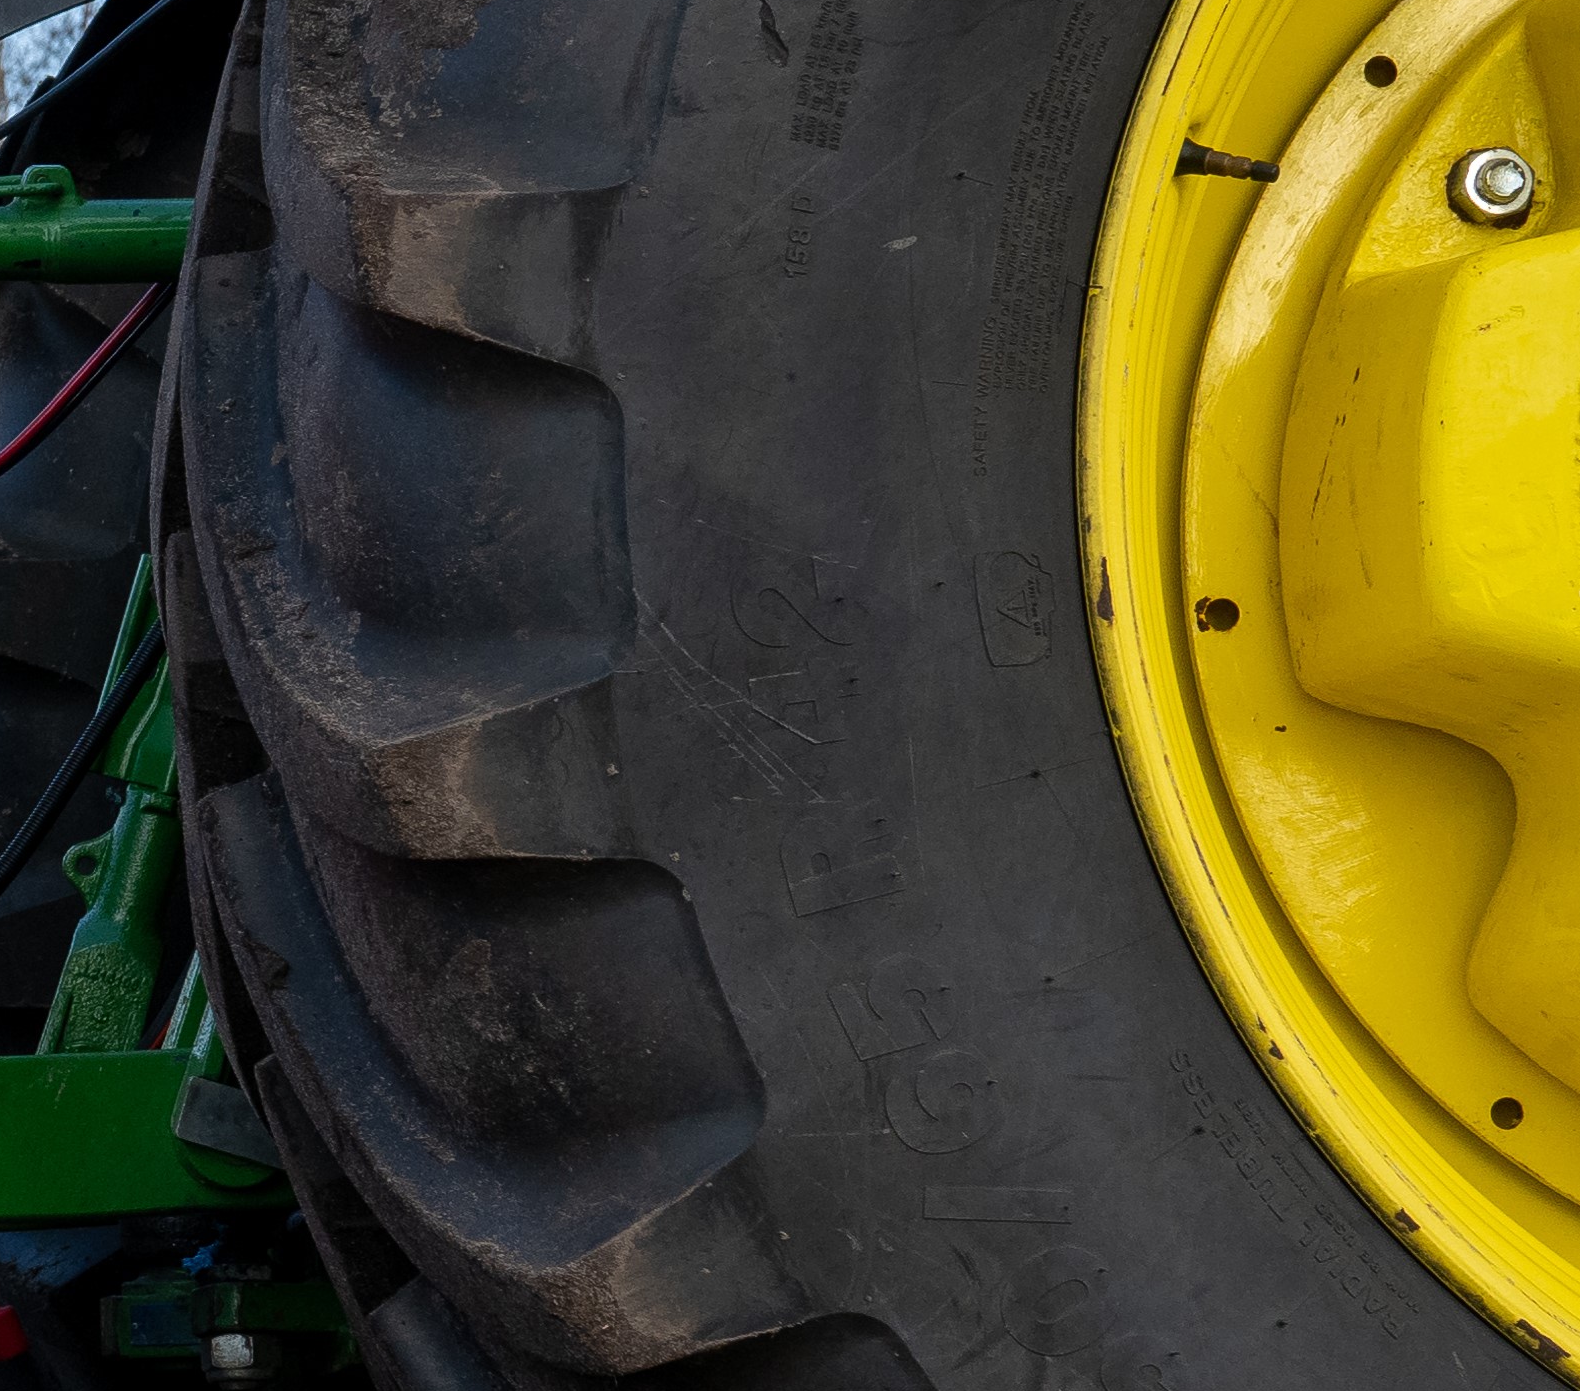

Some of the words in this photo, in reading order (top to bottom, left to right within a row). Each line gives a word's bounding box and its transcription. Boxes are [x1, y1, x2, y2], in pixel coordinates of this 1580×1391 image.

[972, 405, 988, 477] SAFETY
[1168, 1047, 1302, 1225] TUBELESS
[1290, 1219, 1412, 1343] RADIAL
